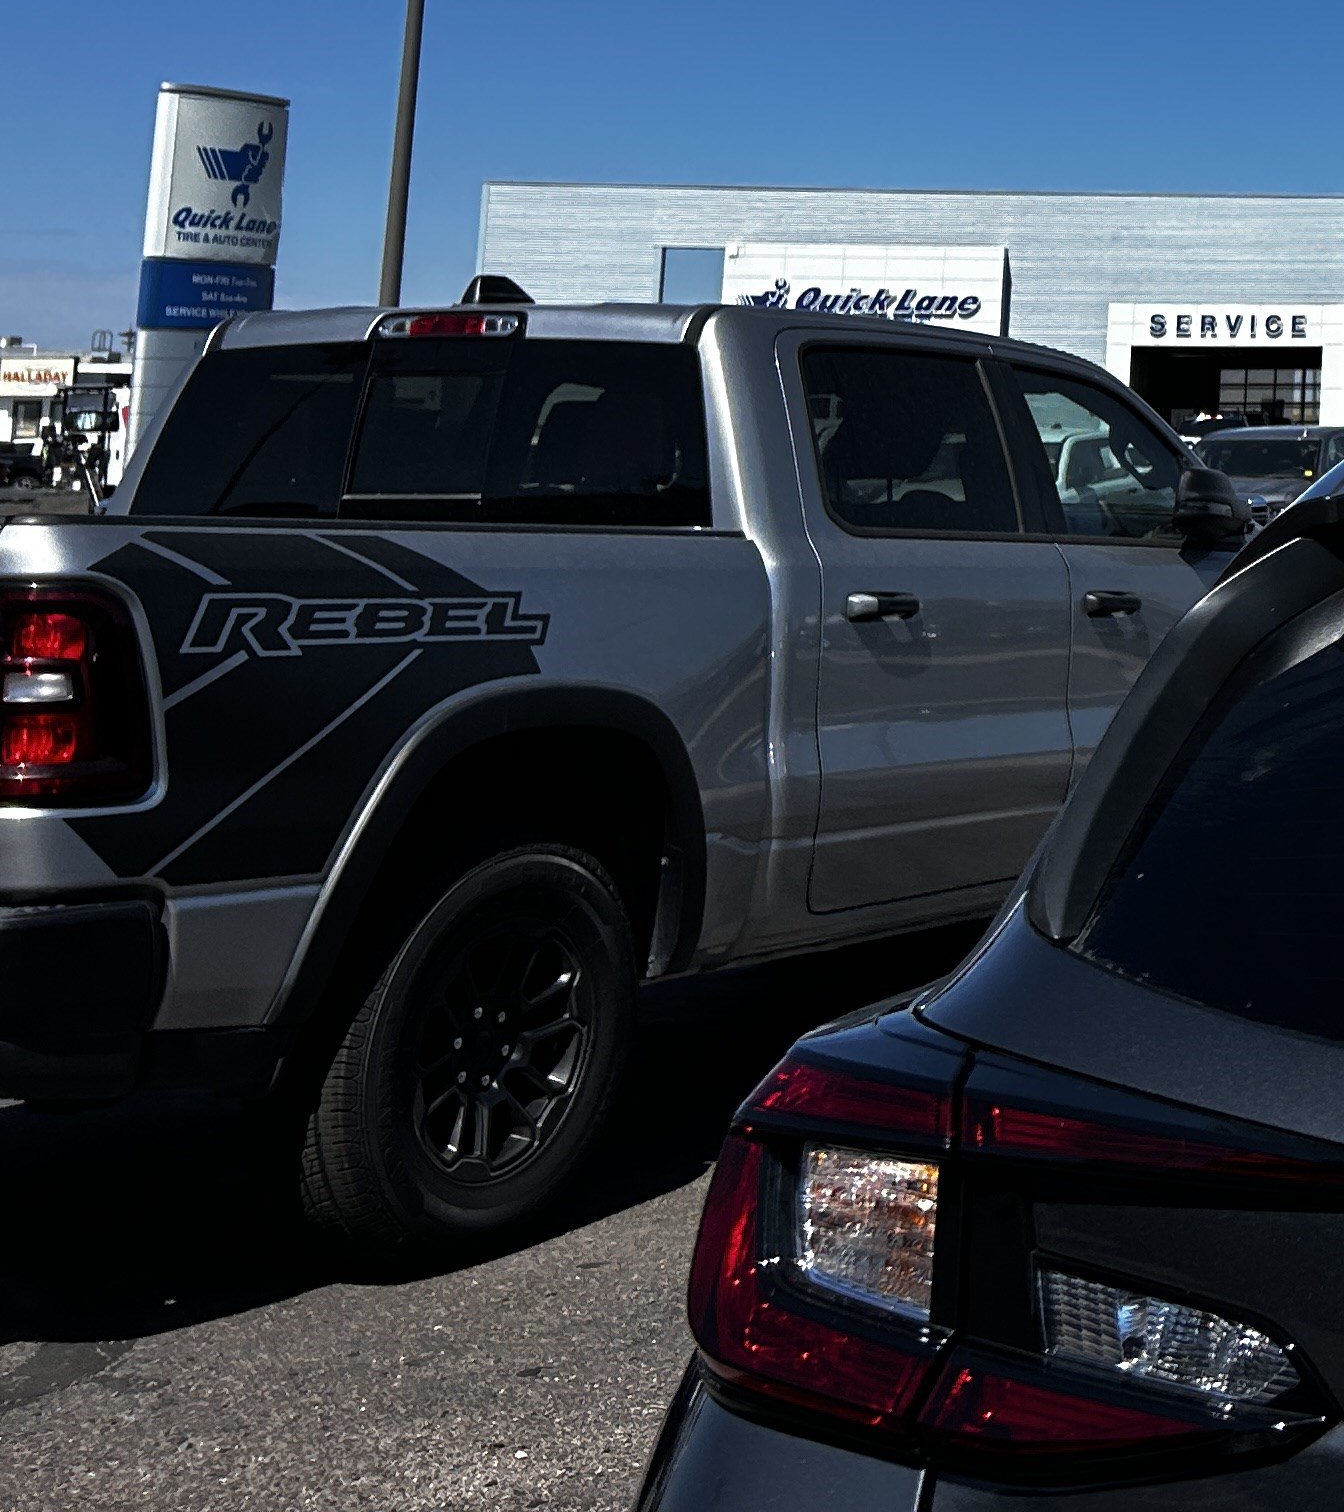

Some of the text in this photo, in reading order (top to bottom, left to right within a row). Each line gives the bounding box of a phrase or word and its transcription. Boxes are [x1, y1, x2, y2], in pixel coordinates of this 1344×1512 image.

[172, 206, 277, 234] Quick Lane
[176, 231, 200, 243] TIRE
[203, 232, 210, 244] &
[212, 234, 238, 247] AUTO
[796, 287, 981, 322] Quick Lane
[1150, 314, 1307, 338] SERVICE
[180, 592, 550, 657] REBEL
